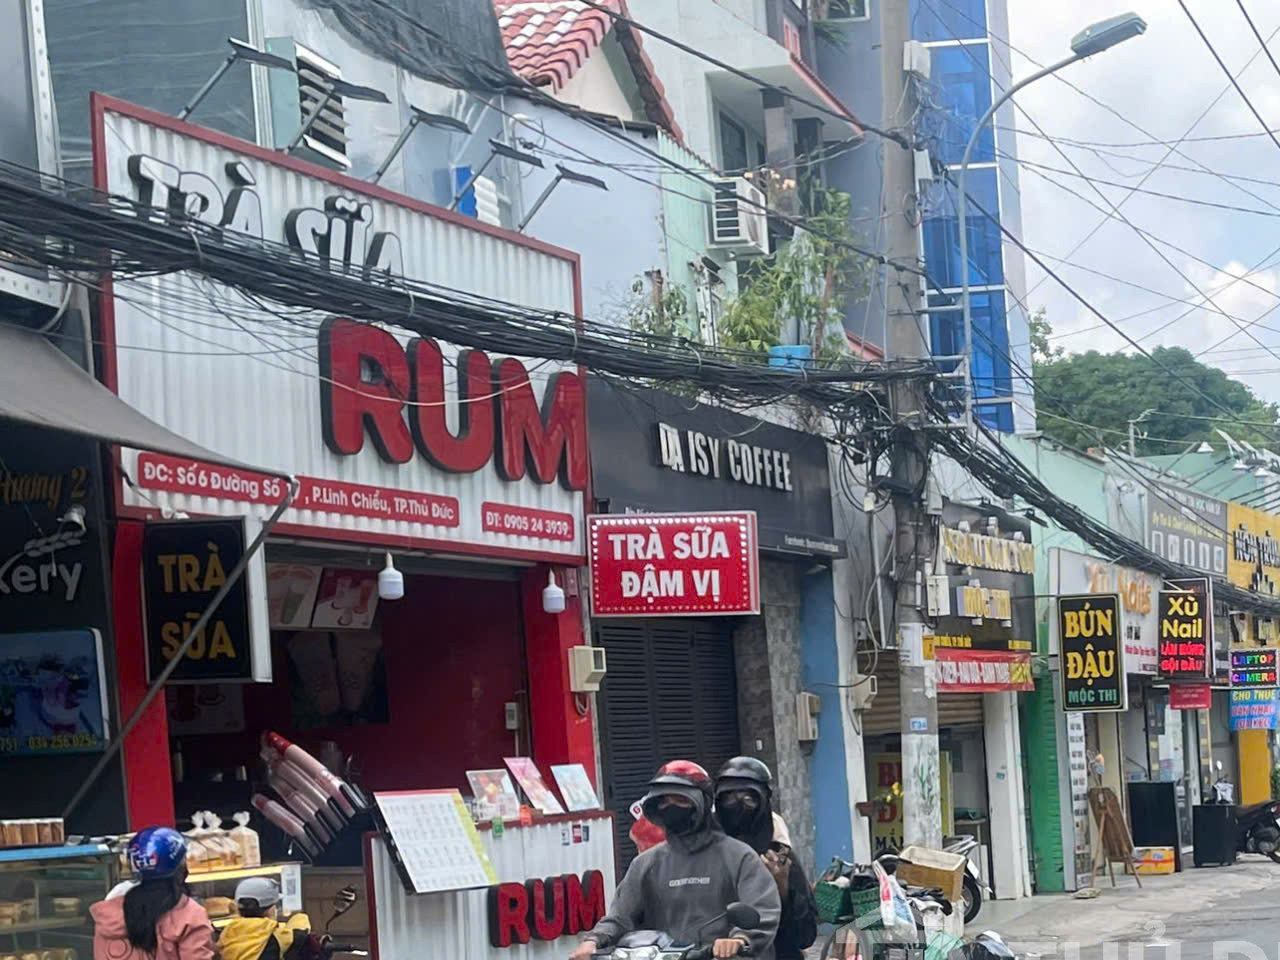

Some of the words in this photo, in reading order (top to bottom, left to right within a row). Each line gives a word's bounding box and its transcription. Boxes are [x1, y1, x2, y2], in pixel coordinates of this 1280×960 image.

[319, 316, 588, 491] RUM
[728, 438, 793, 491] COFFEE
[71, 466, 89, 499] 2
[210, 472, 259, 498] Đường
[263, 477, 281, 497] Số
[504, 513, 528, 531] 0905
[531, 516, 543, 533] 24
[608, 526, 665, 560] TRÀ
[673, 525, 730, 559] SỮA
[158, 541, 228, 593] TRÀ
[621, 563, 684, 603] ĐẬM
[692, 569, 720, 602] VỊ
[1064, 602, 1112, 638] BÚN
[1168, 596, 1198, 616] Xù
[1162, 618, 1202, 638] Nail
[1067, 643, 1114, 685] ĐẬU
[1233, 655, 1274, 665] LAPTOP
[1232, 672, 1276, 683] CAMERA
[1068, 688, 1095, 704] MỘC
[488, 869, 606, 948] RUM
